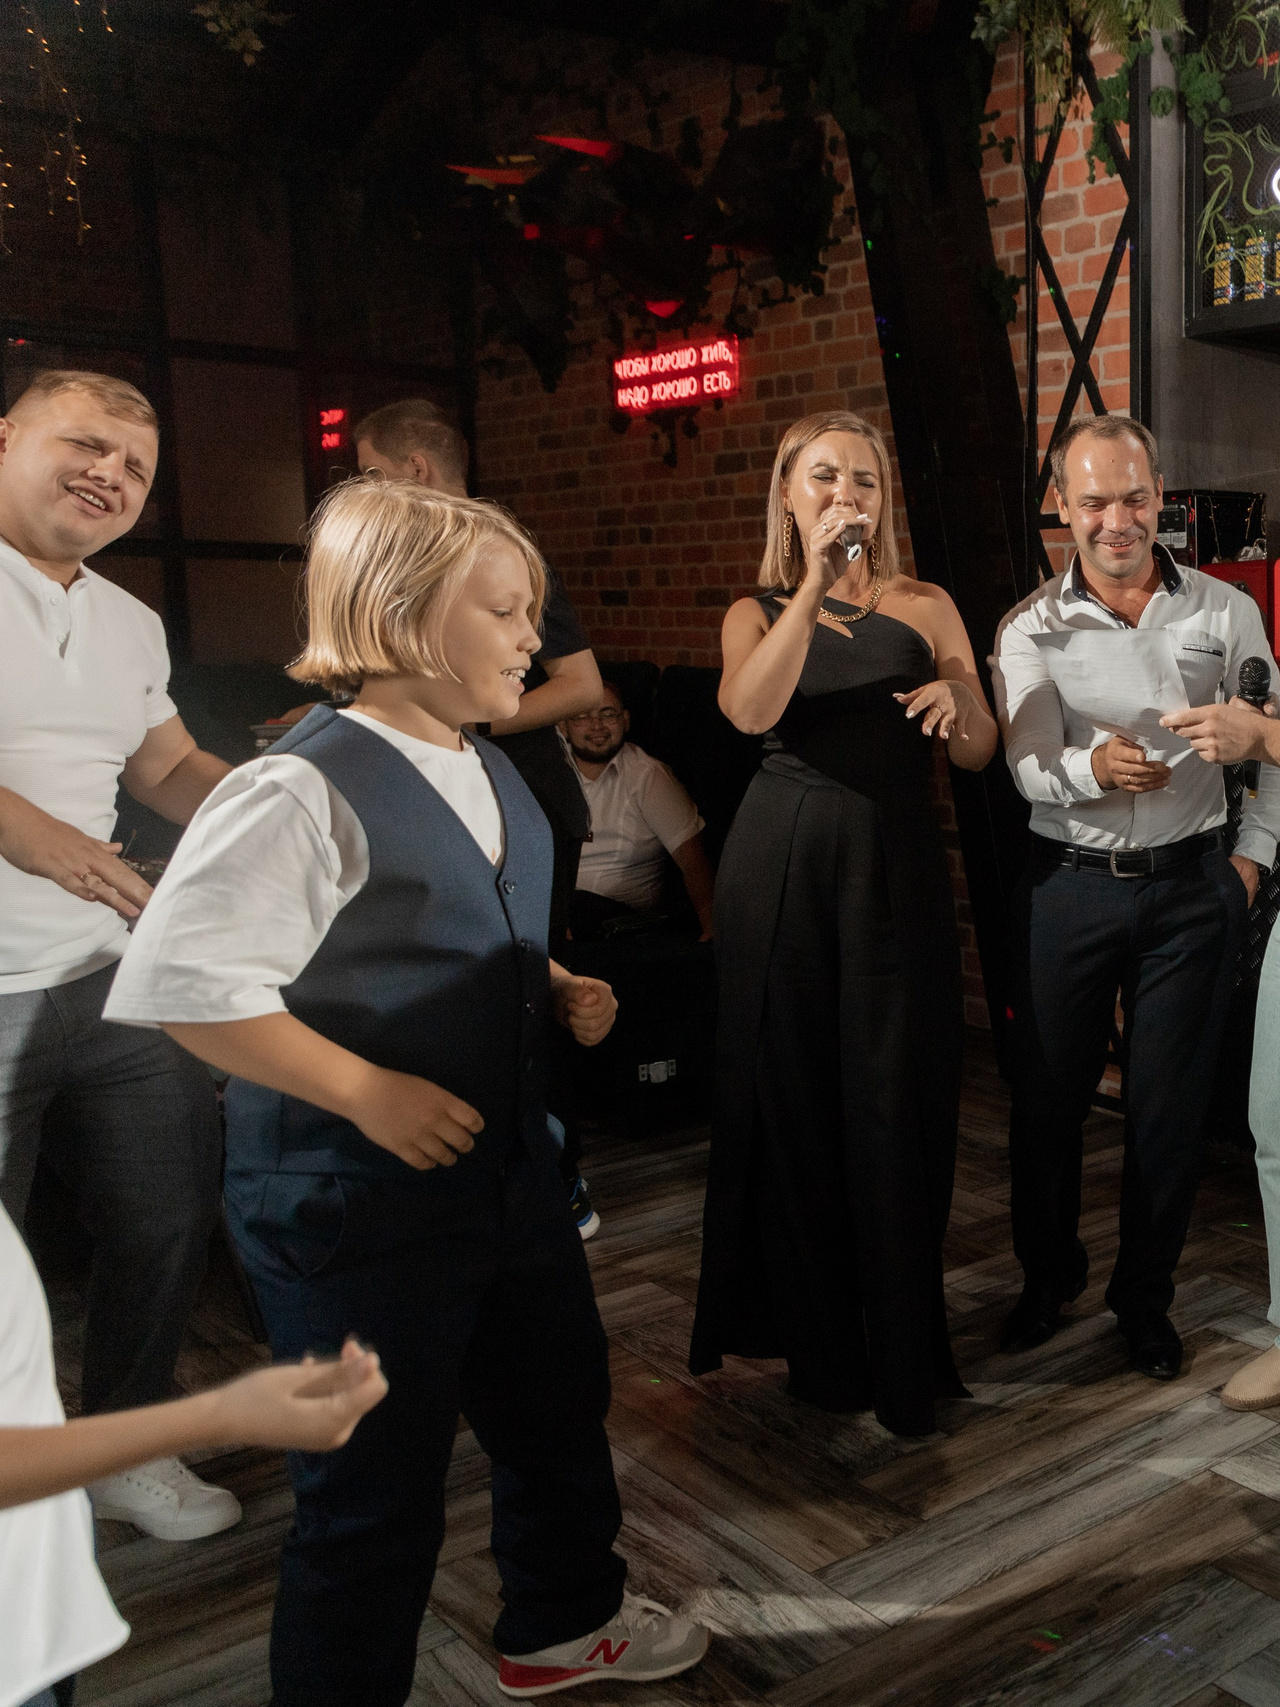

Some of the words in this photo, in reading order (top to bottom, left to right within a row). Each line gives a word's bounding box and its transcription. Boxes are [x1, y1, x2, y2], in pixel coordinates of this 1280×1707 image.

[614, 357, 650, 379] ЧТОБЫ
[651, 347, 697, 373] ХОРОШО
[700, 340, 734, 364] ЖИТЬ,
[617, 385, 649, 409] НАДО
[651, 376, 698, 401] ХОРОШО
[703, 371, 731, 394] ЕСТЬ
[585, 1638, 631, 1665] N
